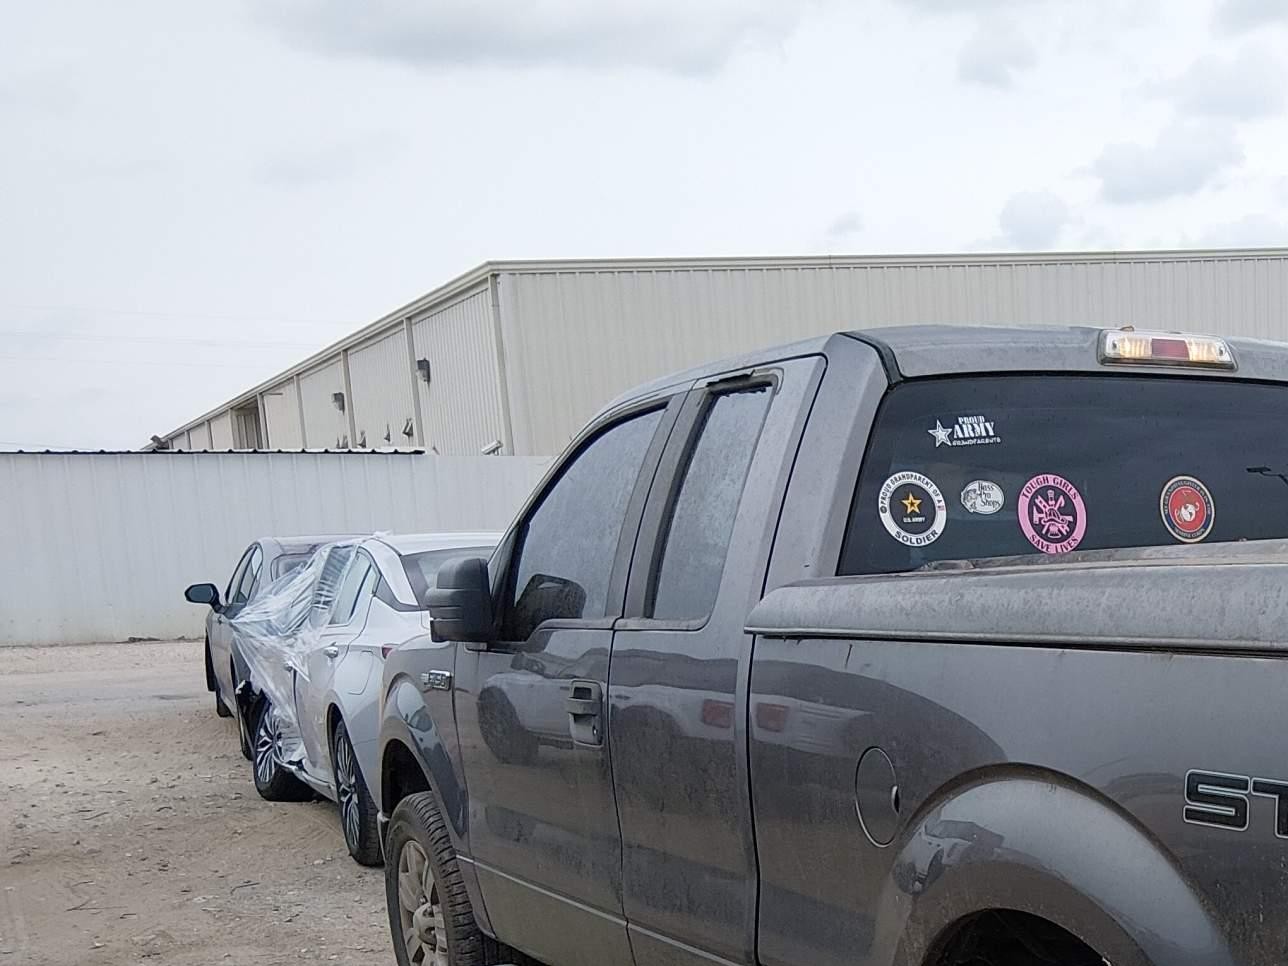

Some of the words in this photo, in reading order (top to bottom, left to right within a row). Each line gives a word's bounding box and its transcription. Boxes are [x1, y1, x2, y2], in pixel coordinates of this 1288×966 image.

[958, 416, 985, 424] PROUD
[953, 422, 995, 438] ARMY
[880, 484, 892, 505] PROUD
[890, 473, 933, 489] GRANDPARENT
[932, 489, 941, 497] OF
[1022, 475, 1049, 499] TOUGH
[1052, 477, 1079, 500] GIRLS
[895, 529, 938, 545] SOLDIER
[1030, 534, 1052, 552] SAVE
[1055, 537, 1079, 553] LIVES
